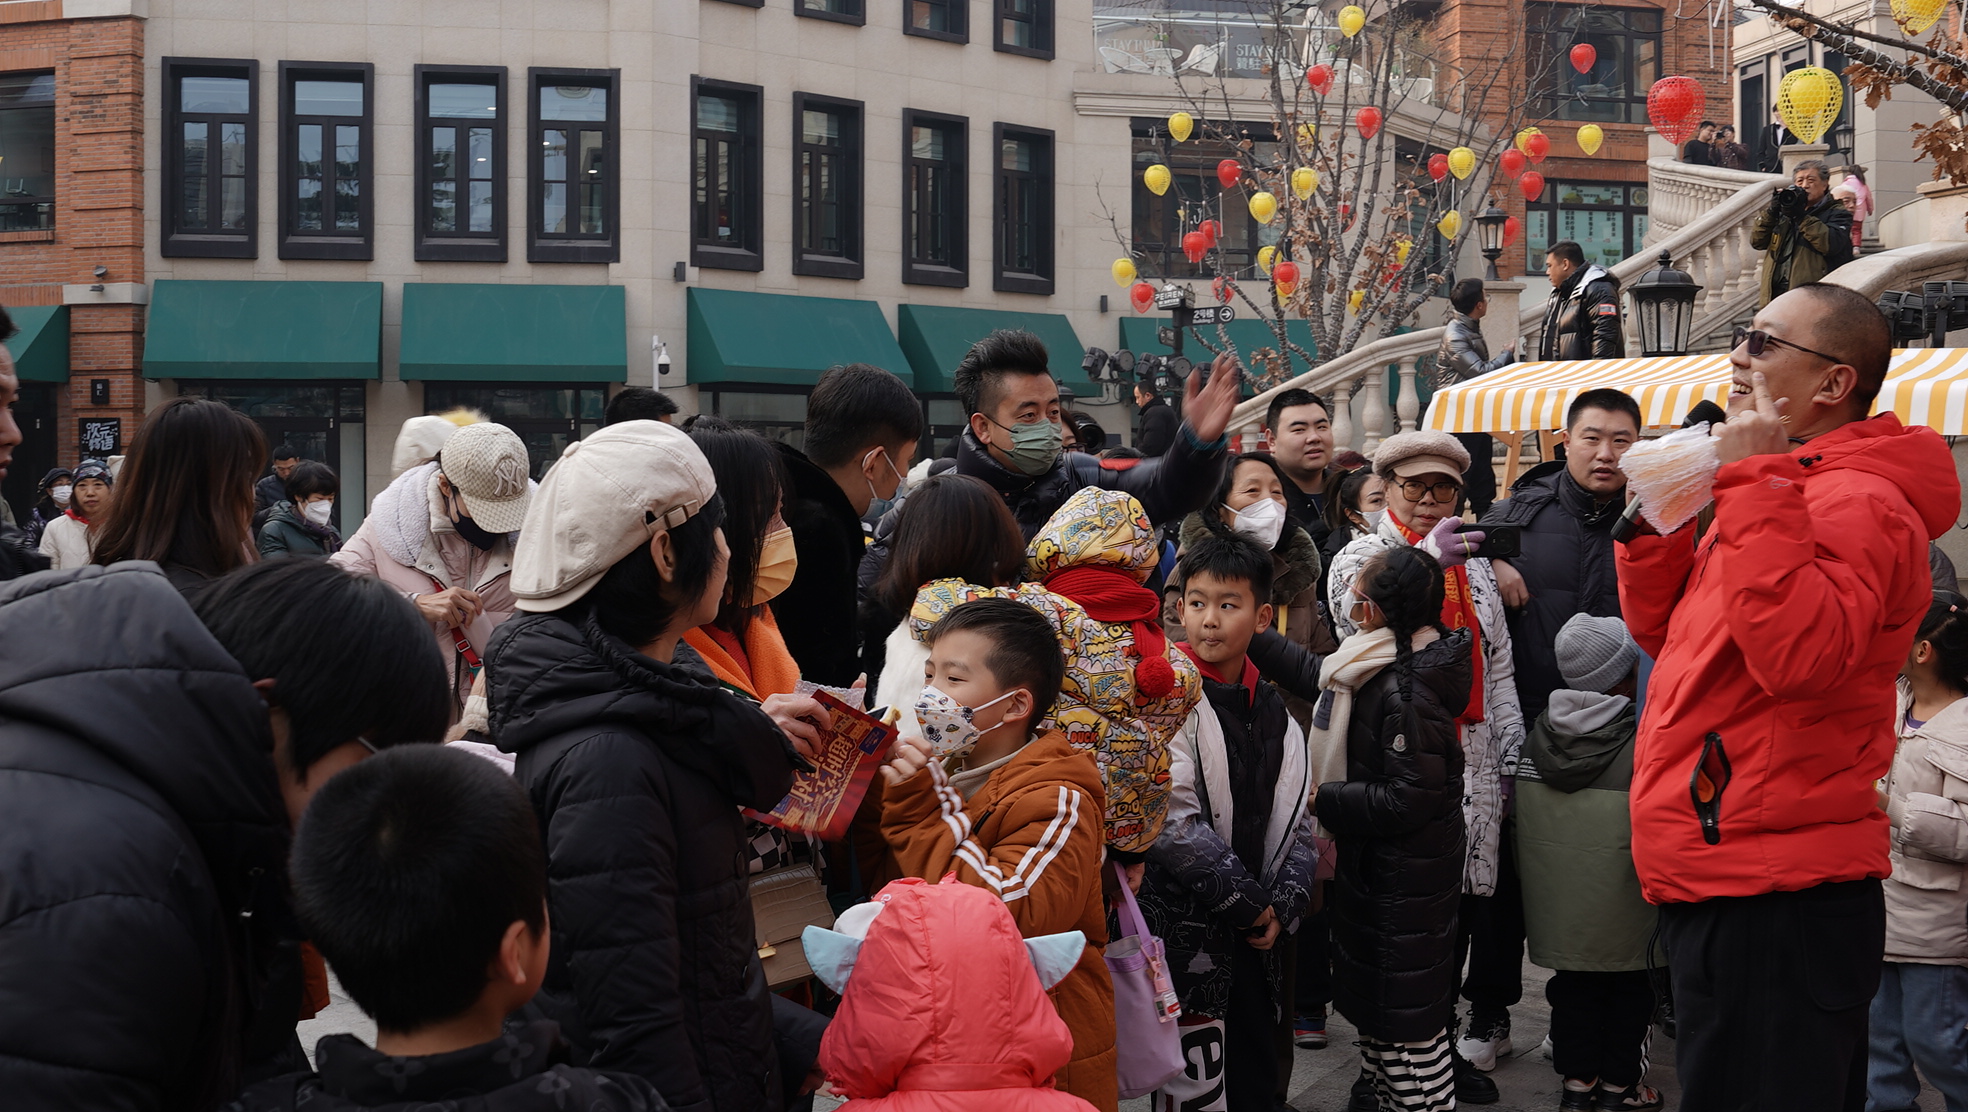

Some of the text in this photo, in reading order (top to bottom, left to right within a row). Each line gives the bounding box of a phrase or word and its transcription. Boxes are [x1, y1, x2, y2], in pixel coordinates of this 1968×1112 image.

[1236, 44, 1264, 56] STAY
[1155, 290, 1184, 300] PEIREN
[86, 421, 117, 440] 次元
[495, 459, 523, 497] NY
[821, 733, 854, 800] 超时空
